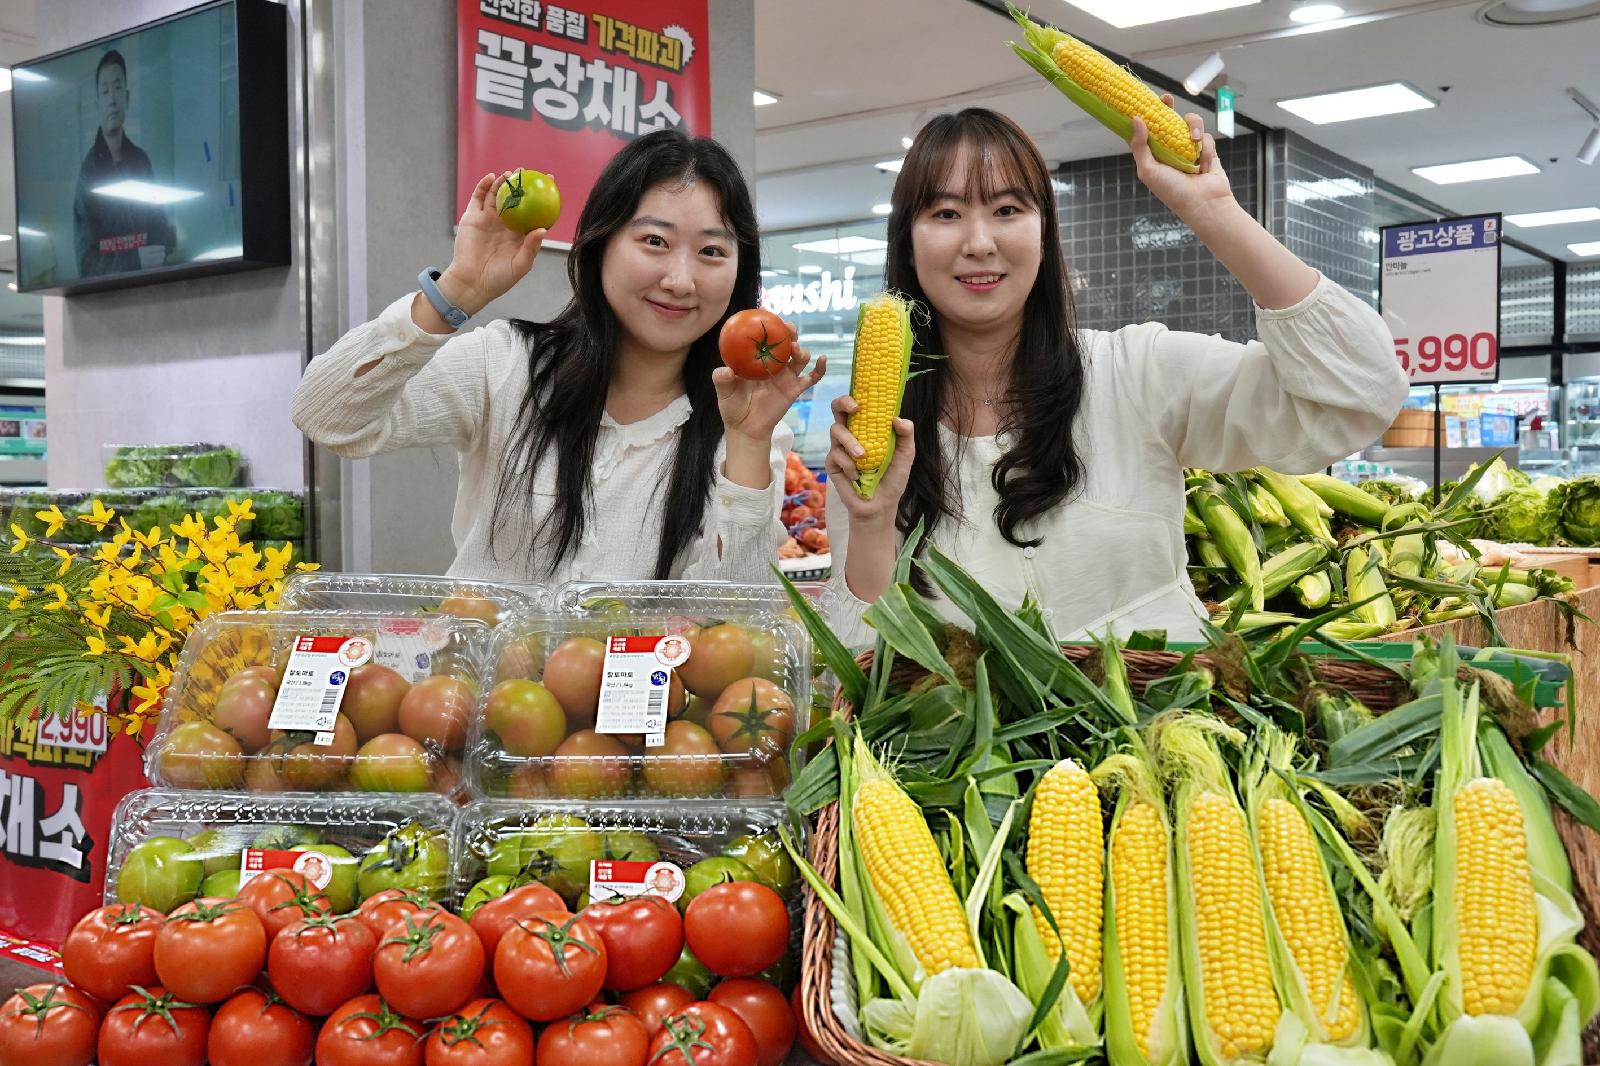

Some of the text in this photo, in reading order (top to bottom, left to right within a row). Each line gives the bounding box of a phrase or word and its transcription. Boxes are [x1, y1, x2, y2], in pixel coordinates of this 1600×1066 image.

[546, 5, 585, 40] 품질
[592, 13, 682, 71] 가격파괴
[475, 29, 682, 135] 끝장채소
[1396, 223, 1475, 252] 광고상품
[1393, 331, 1497, 377] 5,990
